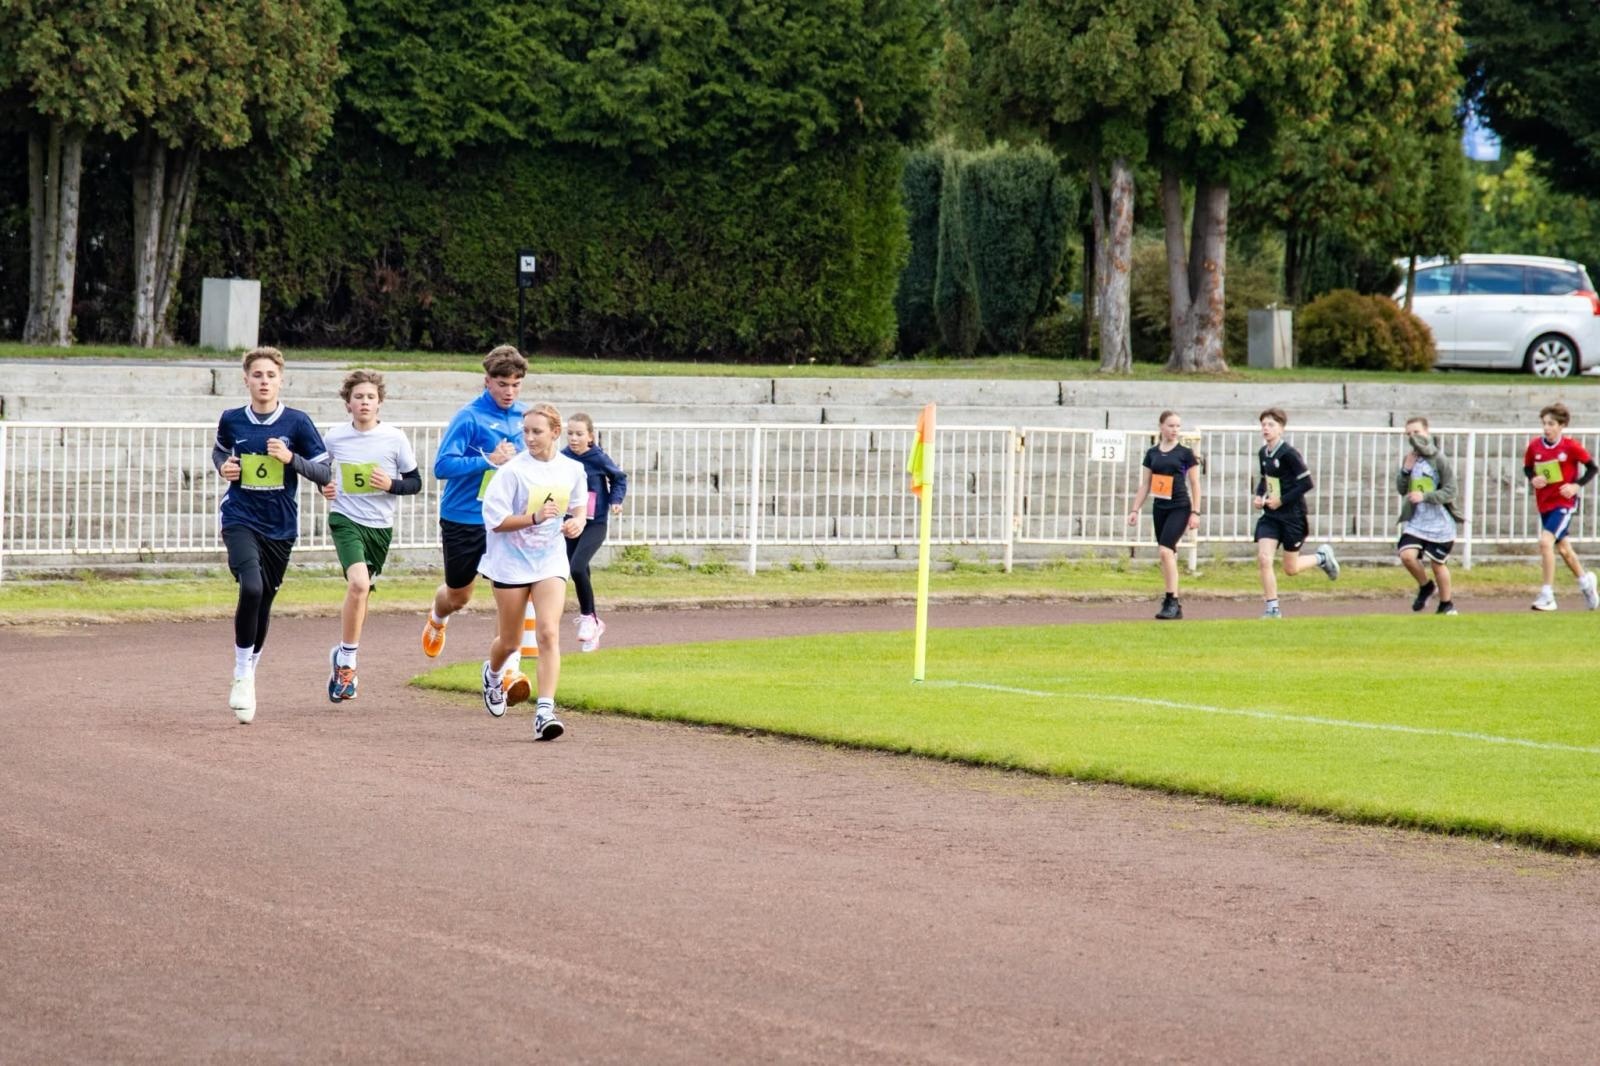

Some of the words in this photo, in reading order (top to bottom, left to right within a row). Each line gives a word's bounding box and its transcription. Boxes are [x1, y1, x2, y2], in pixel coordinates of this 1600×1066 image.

[1101, 446, 1115, 459] 13
[256, 463, 267, 478] 6
[354, 473, 365, 487] 5
